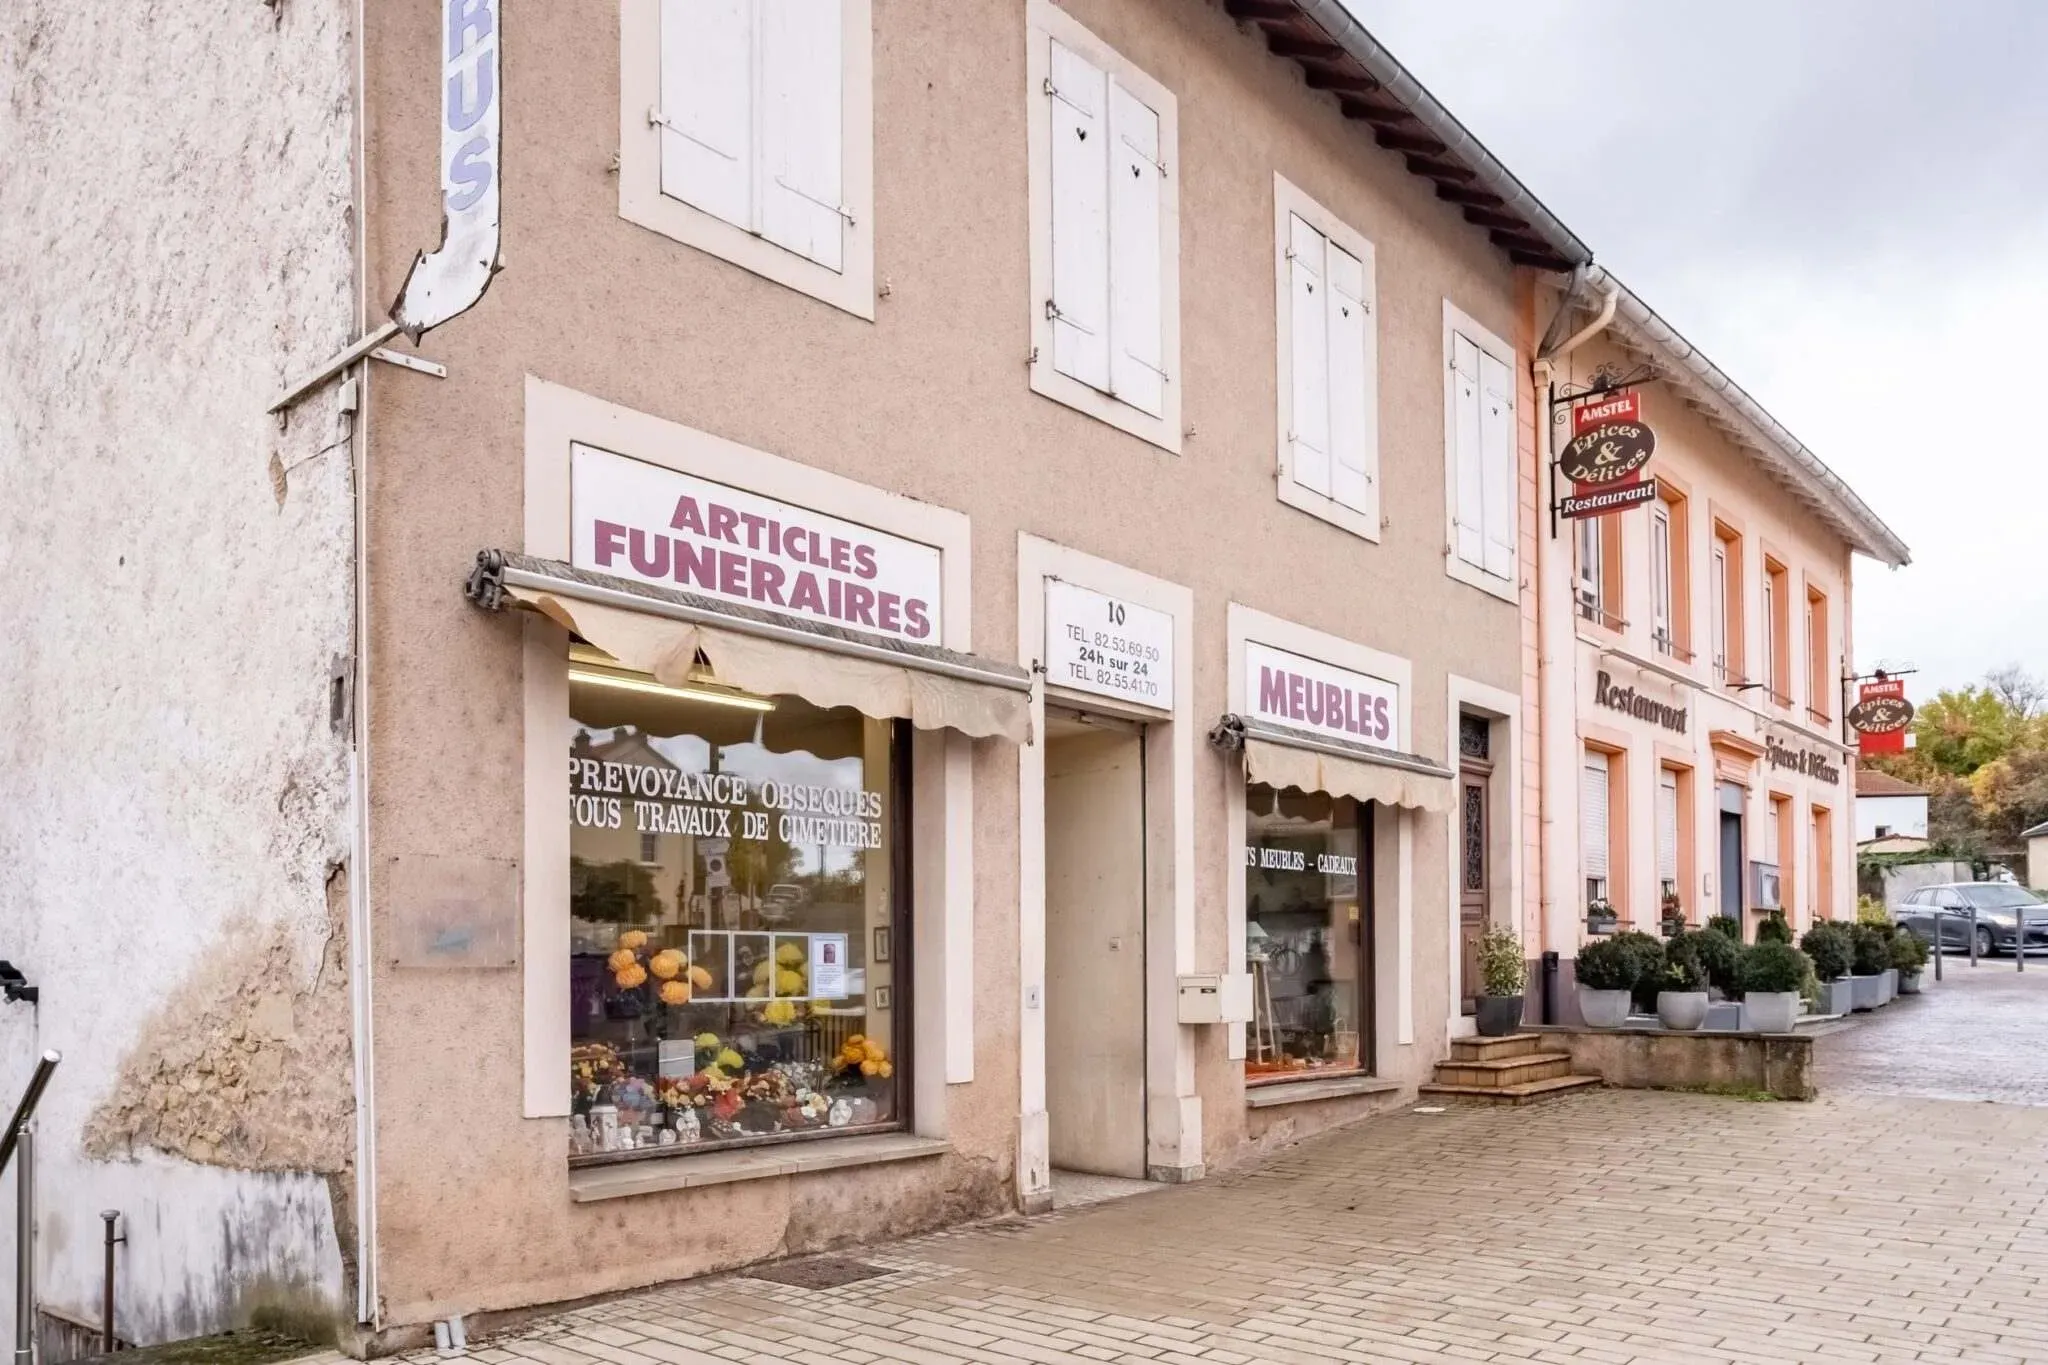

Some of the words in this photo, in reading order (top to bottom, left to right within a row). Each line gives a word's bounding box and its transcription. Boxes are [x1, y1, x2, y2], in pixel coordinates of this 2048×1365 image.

[1581, 400, 1633, 422] AMSTEL
[1570, 449, 1646, 482] Délices
[1594, 441, 1624, 466] &
[1563, 483, 1654, 514] Restaurant
[669, 495, 879, 580] ARTICLES
[594, 519, 932, 639] FUNERAIRES
[1108, 601, 1125, 626] 10
[1080, 646, 1104, 665] 24h
[1109, 657, 1129, 671] sur
[1133, 660, 1148, 677] 24
[1095, 631, 1160, 662] 82.53.69.50
[1260, 666, 1390, 741] MEUBLES
[1595, 670, 1688, 735] Restaurant
[1863, 683, 1900, 694] AMSTEL
[1872, 707, 1893, 722] &
[1799, 748, 1807, 774] &
[761, 780, 882, 818] OBSEQUES
[634, 800, 731, 838] TRAVAUX
[743, 811, 769, 840] DE
[779, 816, 882, 849] CIMETIERE
[1260, 847, 1304, 871] MEUBLES
[1317, 853, 1357, 875] CADEAUX
